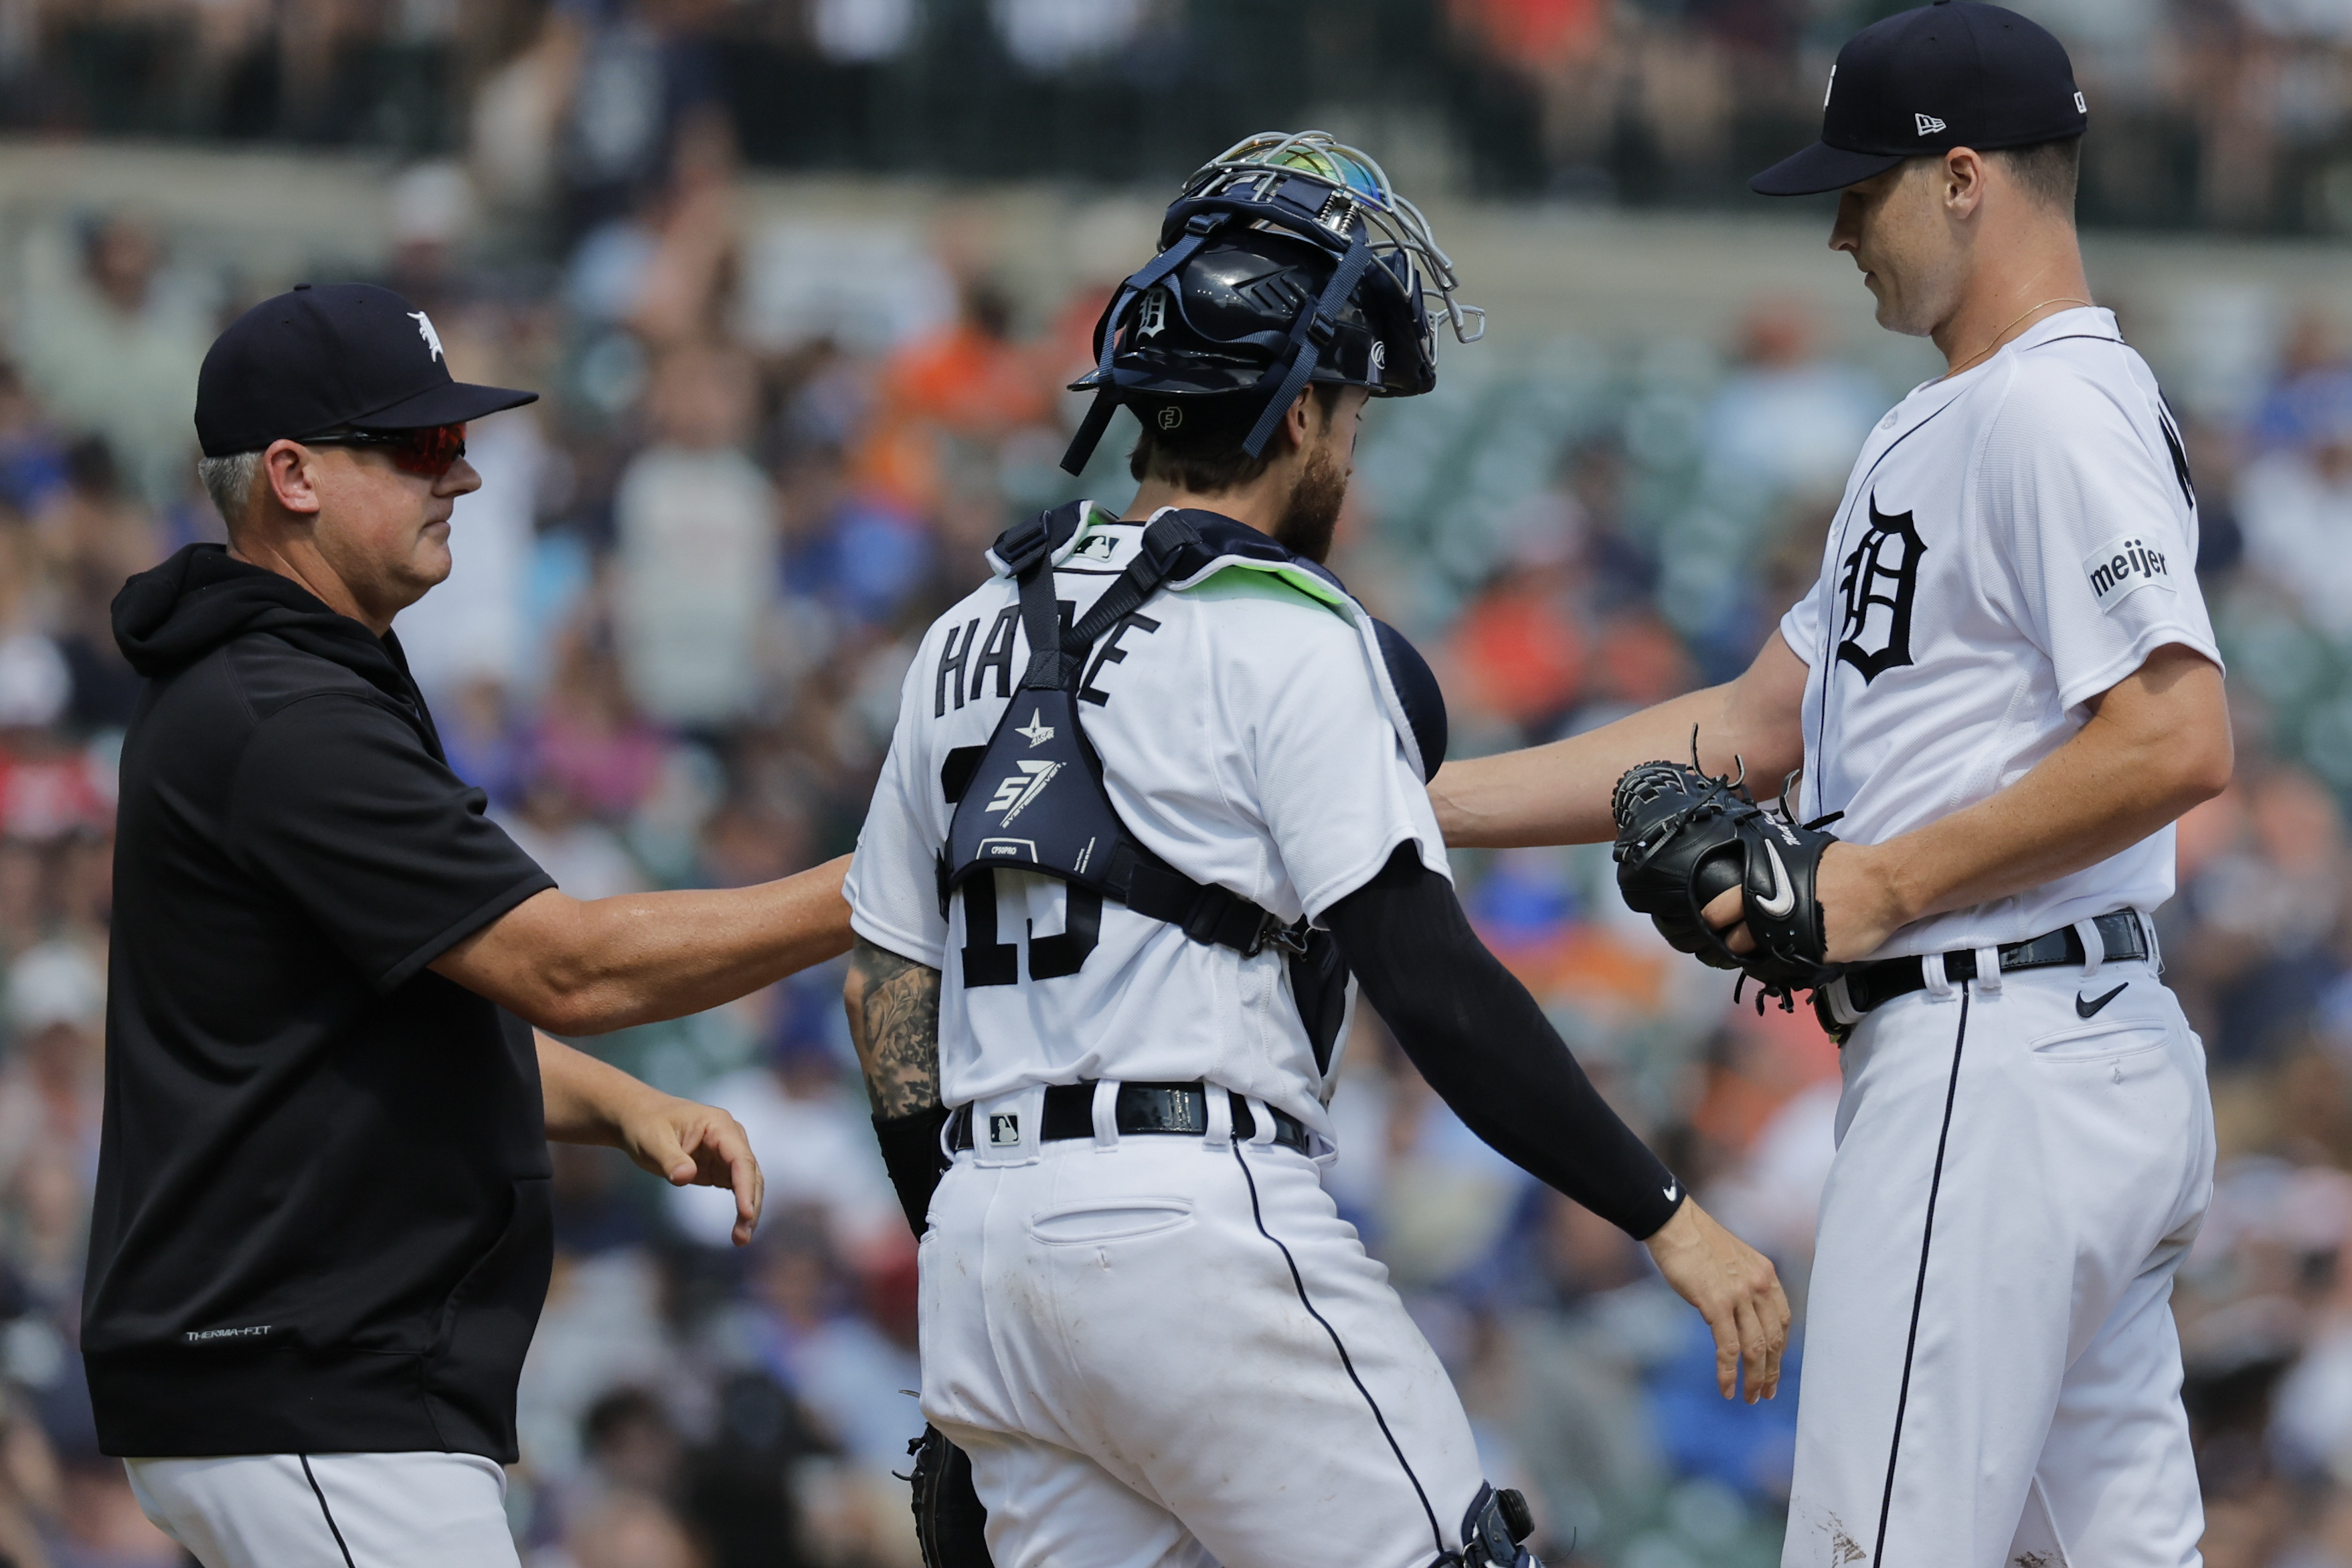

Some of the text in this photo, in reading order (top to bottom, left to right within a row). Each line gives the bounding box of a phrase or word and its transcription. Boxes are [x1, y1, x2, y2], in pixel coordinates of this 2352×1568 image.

[1835, 483, 1928, 687] D
[2090, 539, 2168, 598] meijer
[186, 1325, 272, 1341] THERMA-FIT
